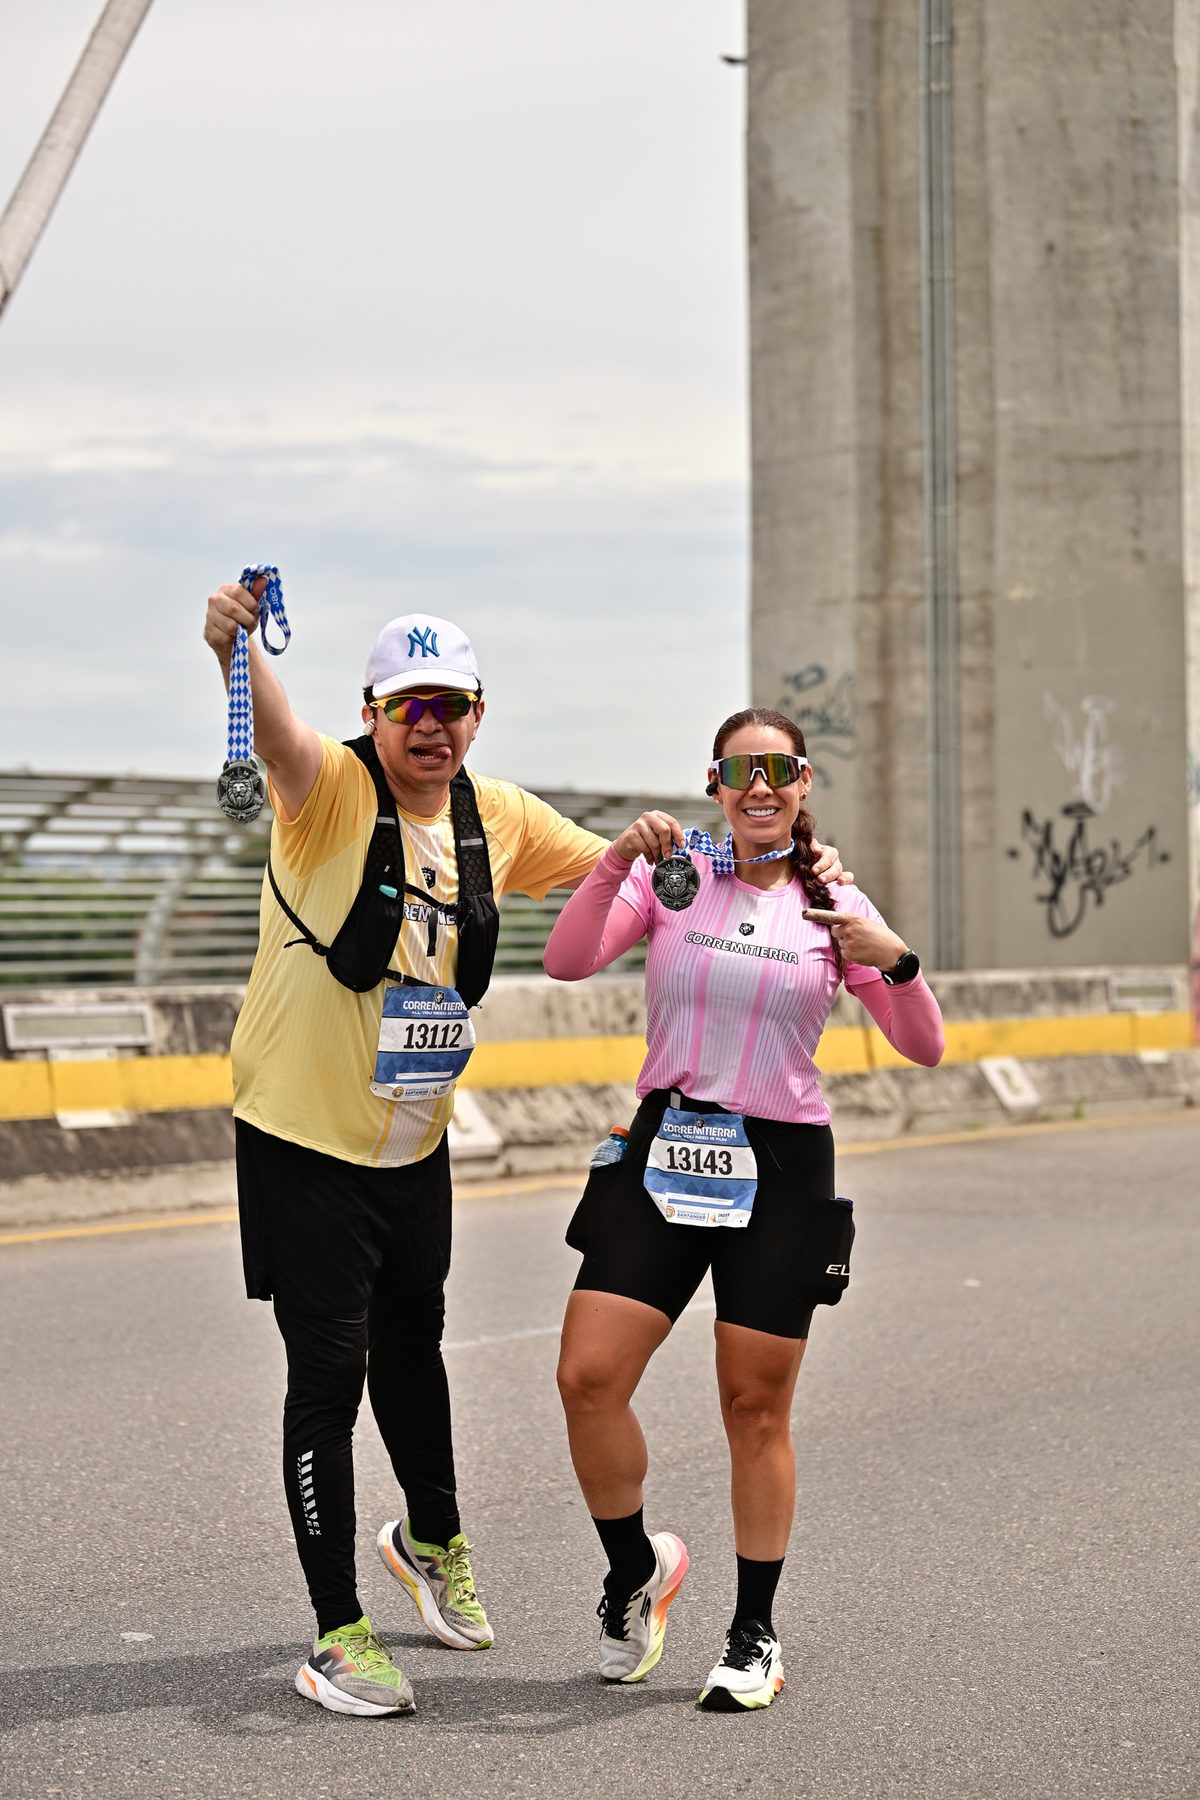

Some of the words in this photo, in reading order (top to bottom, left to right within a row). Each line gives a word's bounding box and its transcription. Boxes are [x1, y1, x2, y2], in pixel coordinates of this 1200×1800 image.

[685, 931, 798, 965] CORREMITIERRA
[403, 1023, 463, 1049] 13112
[662, 1122, 737, 1138] CORREMITIERRA
[666, 1146, 733, 1175] 13143
